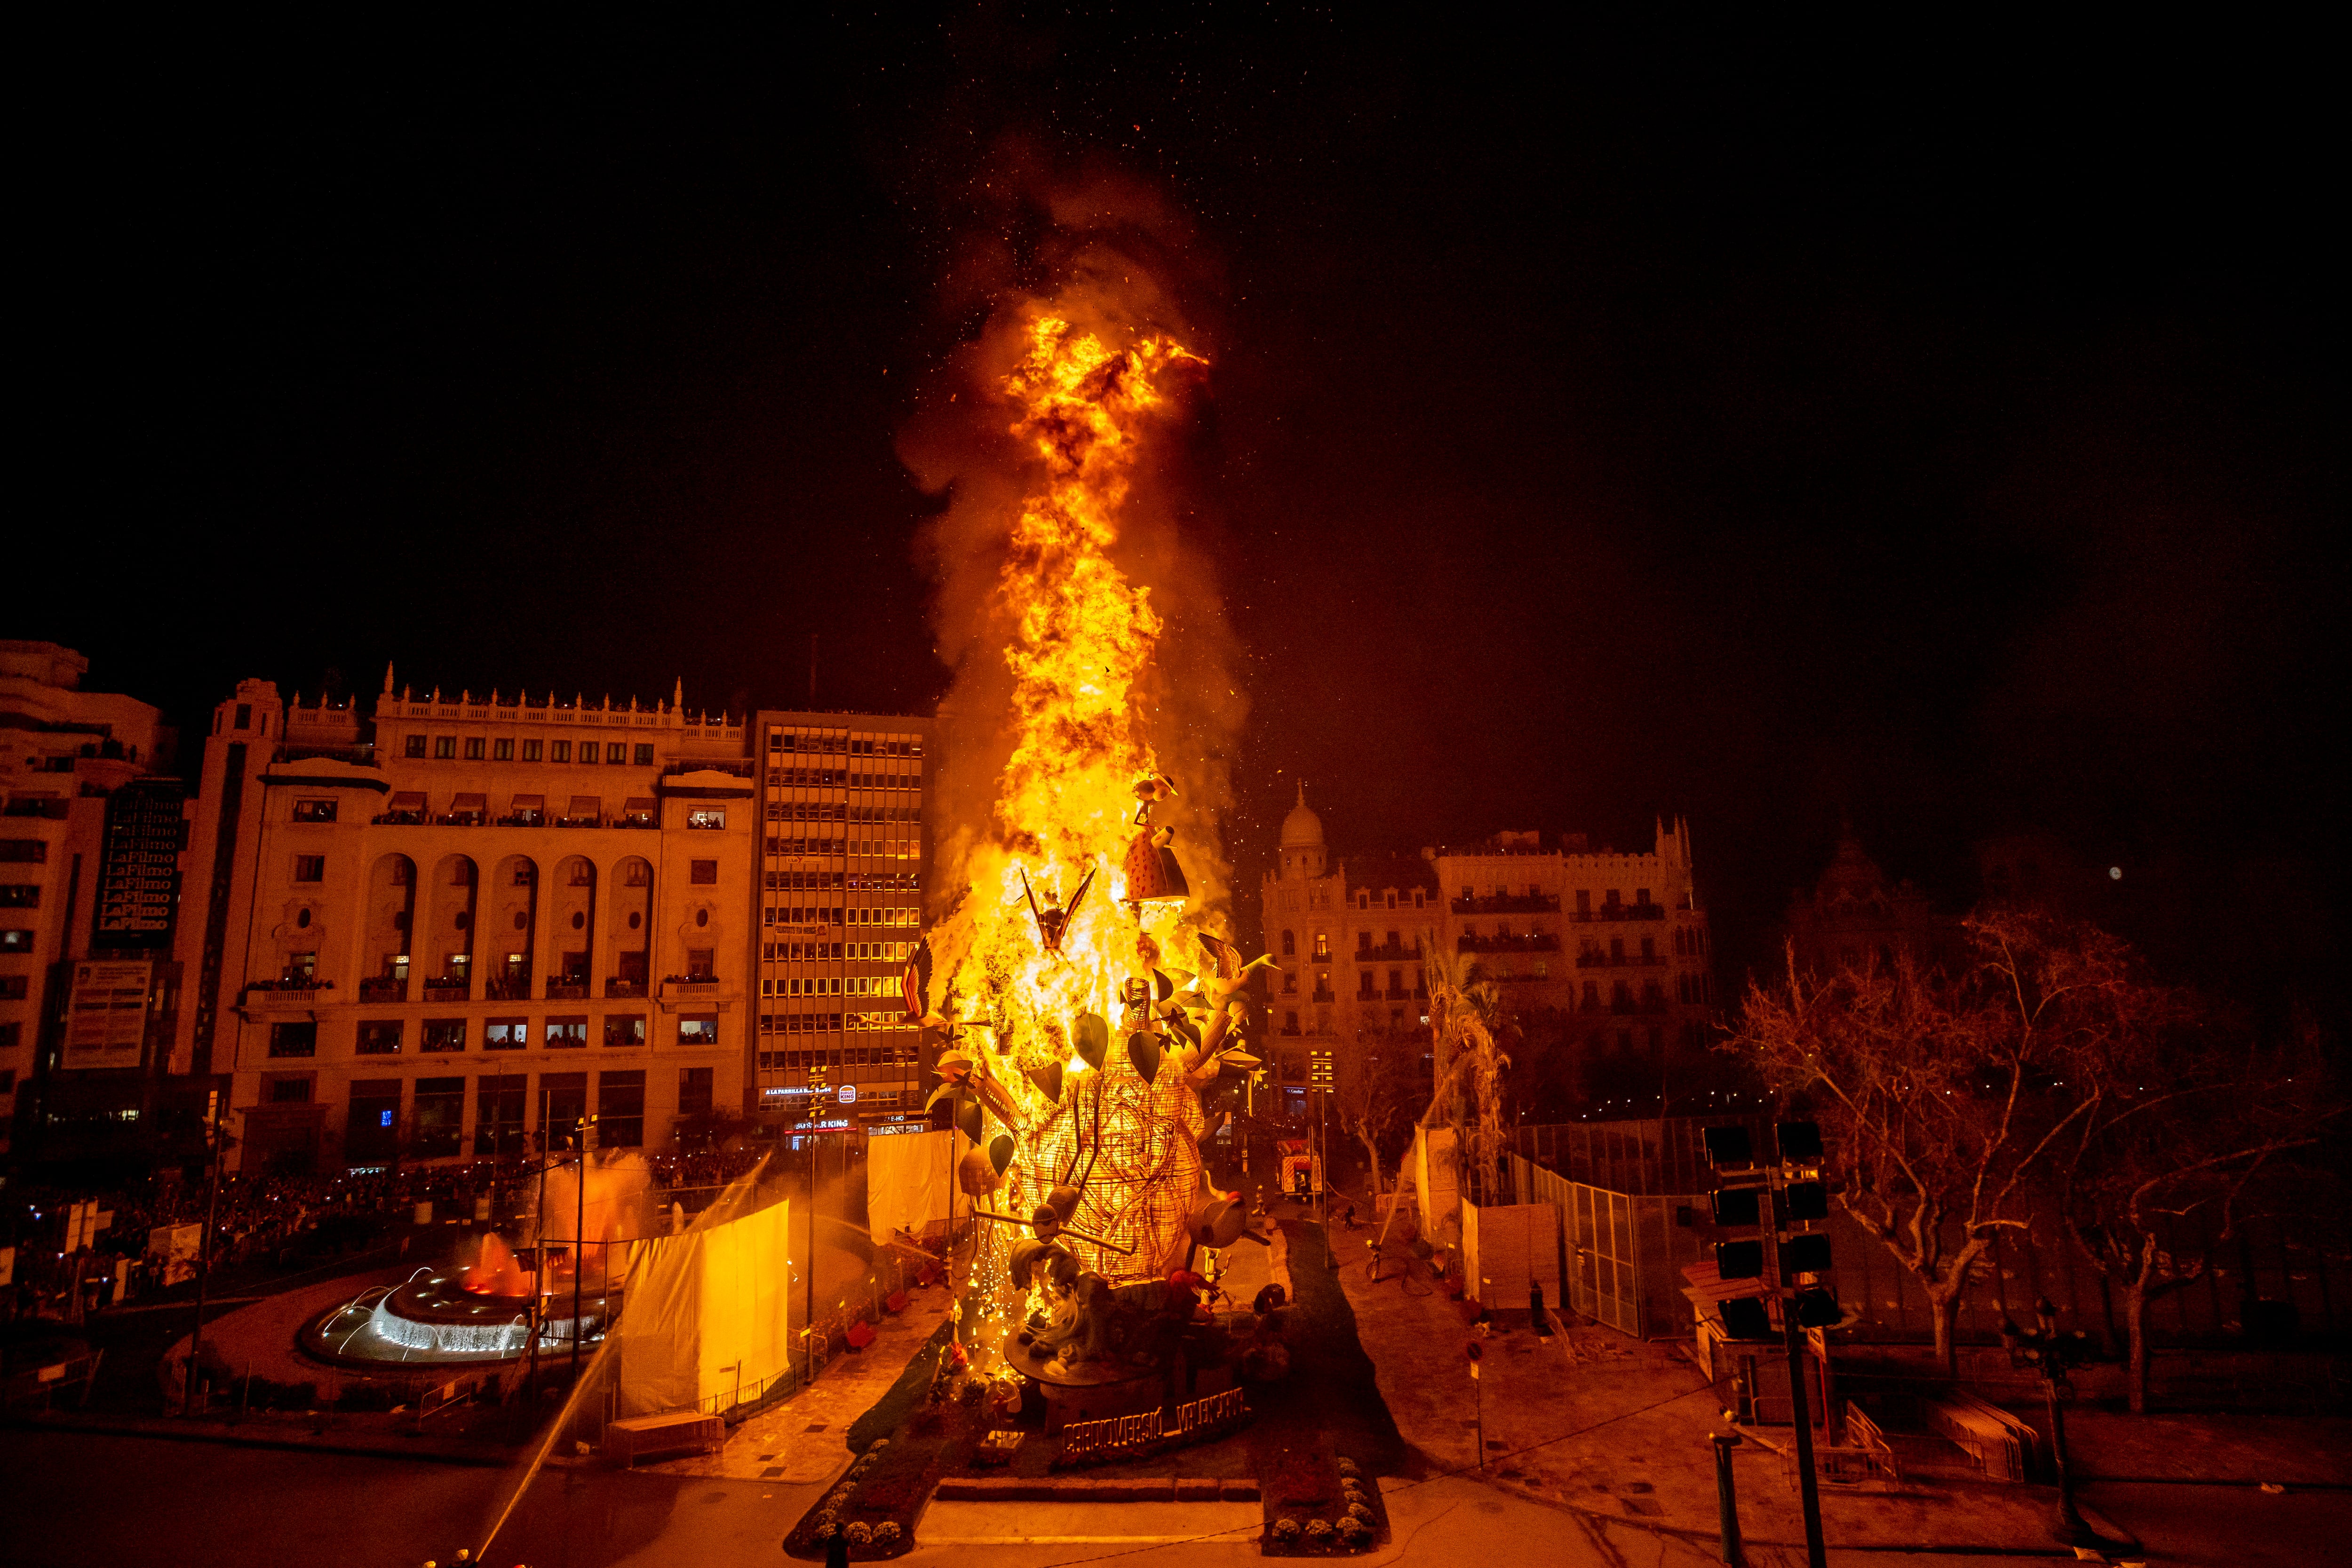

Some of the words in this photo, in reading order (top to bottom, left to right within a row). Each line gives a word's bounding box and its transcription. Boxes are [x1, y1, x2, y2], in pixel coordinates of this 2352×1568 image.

[113, 811, 178, 823] LaFilmo
[111, 825, 177, 836] LaFilmo
[110, 838, 175, 849] LaFilmo
[108, 851, 174, 863] LaFilmo
[106, 864, 173, 876] LaFilmo
[104, 877, 171, 889] LaFilmo
[103, 891, 170, 903] LaFilmo
[101, 904, 168, 917] LaFilmo
[99, 917, 168, 930] LaFilmo
[795, 1121, 826, 1129] BURR
[828, 1119, 848, 1128] KING
